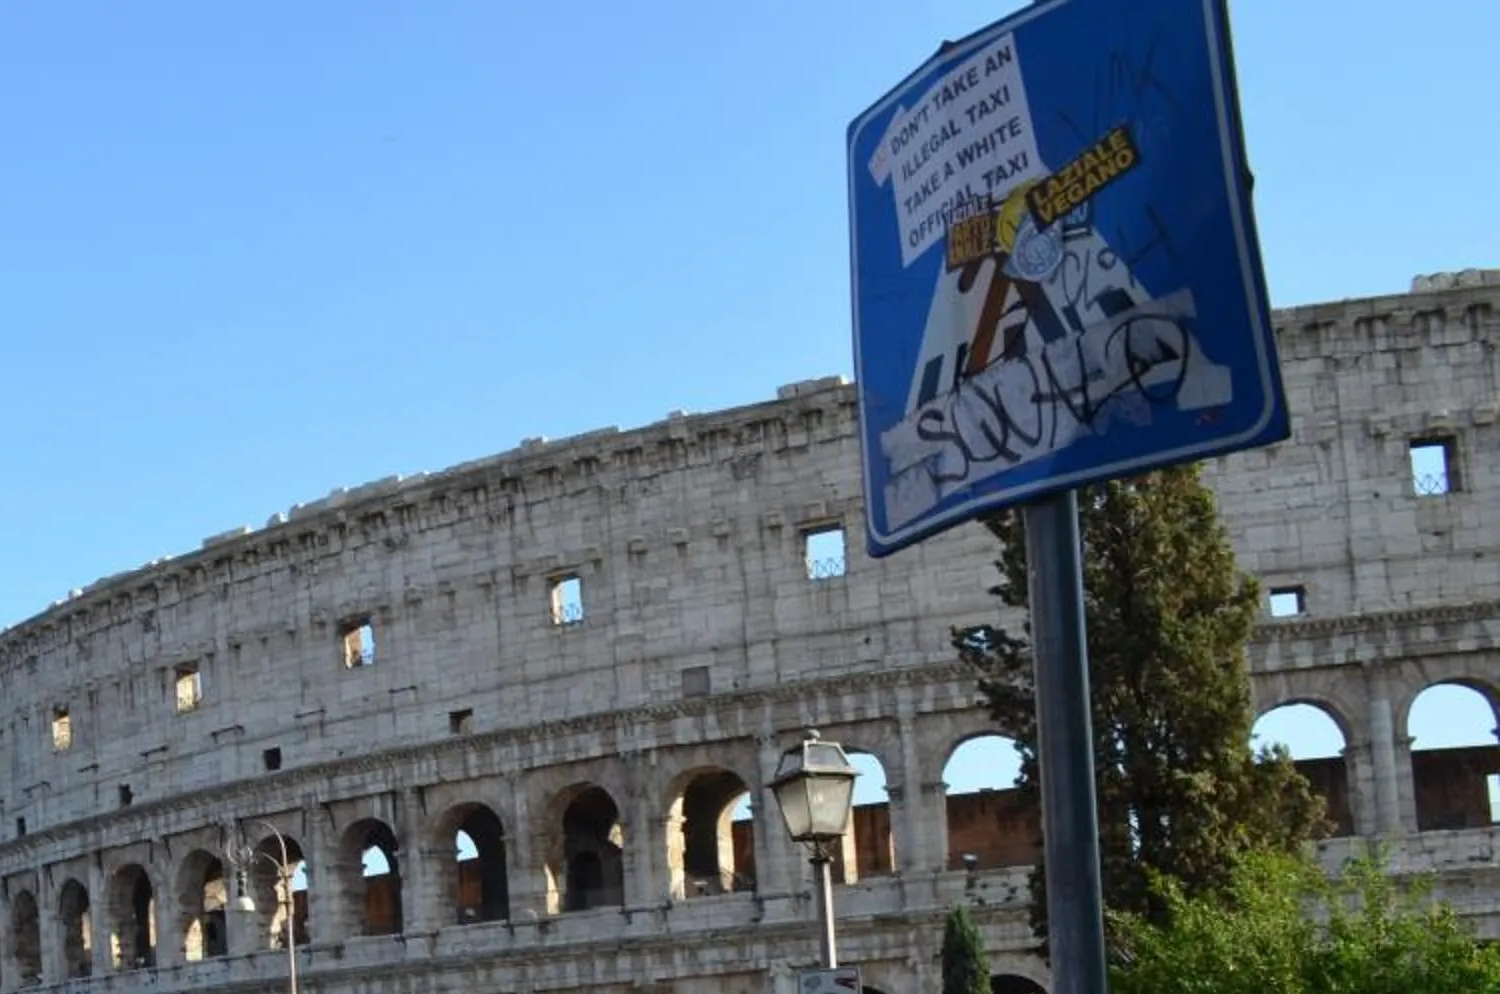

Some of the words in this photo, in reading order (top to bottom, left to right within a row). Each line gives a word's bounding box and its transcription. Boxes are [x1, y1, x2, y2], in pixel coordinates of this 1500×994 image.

[889, 104, 930, 156] DON'T
[932, 67, 980, 110] TAKE
[984, 46, 1012, 77] AN
[901, 119, 961, 184] ILLEGAL
[964, 84, 1011, 126] TAXI
[903, 172, 941, 215] TAKE
[943, 161, 955, 178] A
[956, 116, 1023, 170] WHITE
[908, 183, 978, 249] OFFICIAL
[982, 151, 1029, 191] TAXI
[1034, 128, 1126, 206] LAZIALE
[1037, 150, 1135, 224] VEGANO
